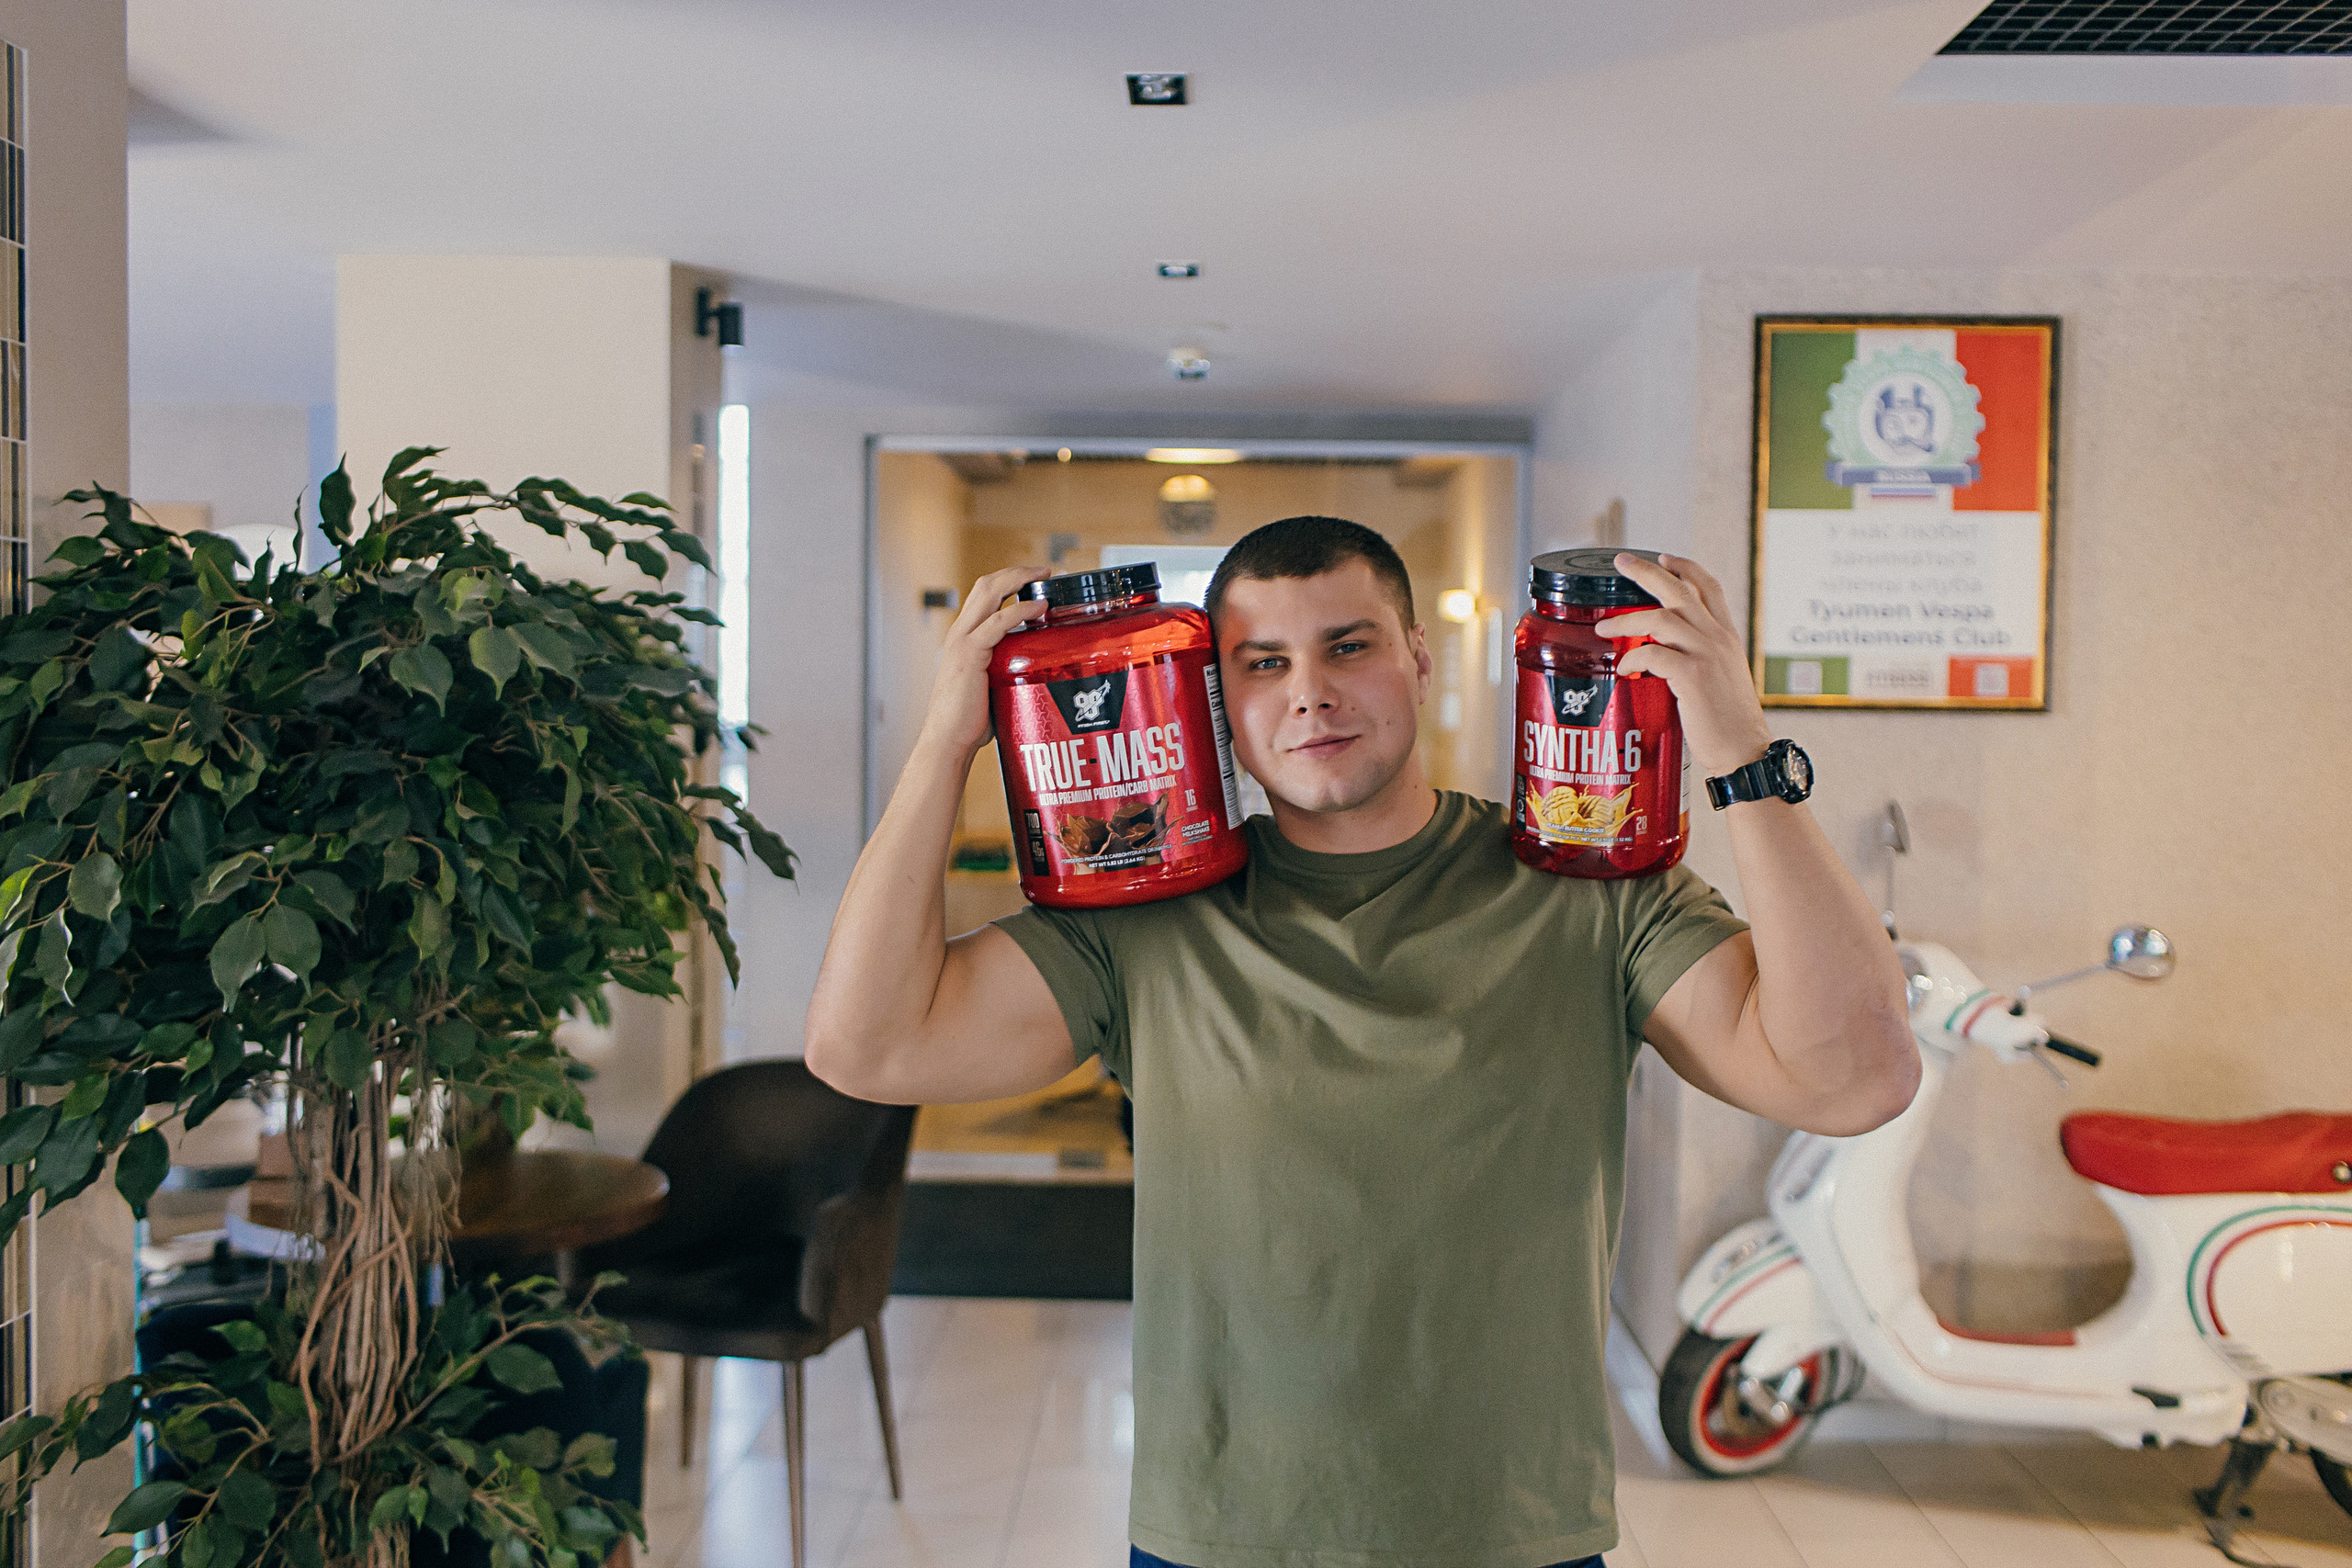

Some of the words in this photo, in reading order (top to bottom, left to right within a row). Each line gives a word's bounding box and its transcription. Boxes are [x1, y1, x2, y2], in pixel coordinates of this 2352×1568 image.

[1808, 599, 1912, 622] Tyumen
[1918, 600, 1996, 622] Vespa
[1790, 626, 1946, 645] Gentlemens
[1952, 626, 2012, 645] Club
[1544, 768, 1574, 784] PREMIUM
[1575, 773, 1604, 785] PROTEIN
[1605, 773, 1632, 785] MATRIX
[1058, 790, 1092, 805] PREMIUM
[1093, 782, 1148, 800] PROTEIN/CARB
[1149, 774, 1177, 791] MATRIX
[1184, 788, 1196, 807] 16
[1182, 819, 1209, 832] CHOCOLATE
[1635, 815, 1647, 830] 28
[1182, 826, 1210, 838] MILKSHAKE
[1109, 849, 1147, 860] CARBOHYDRATE
